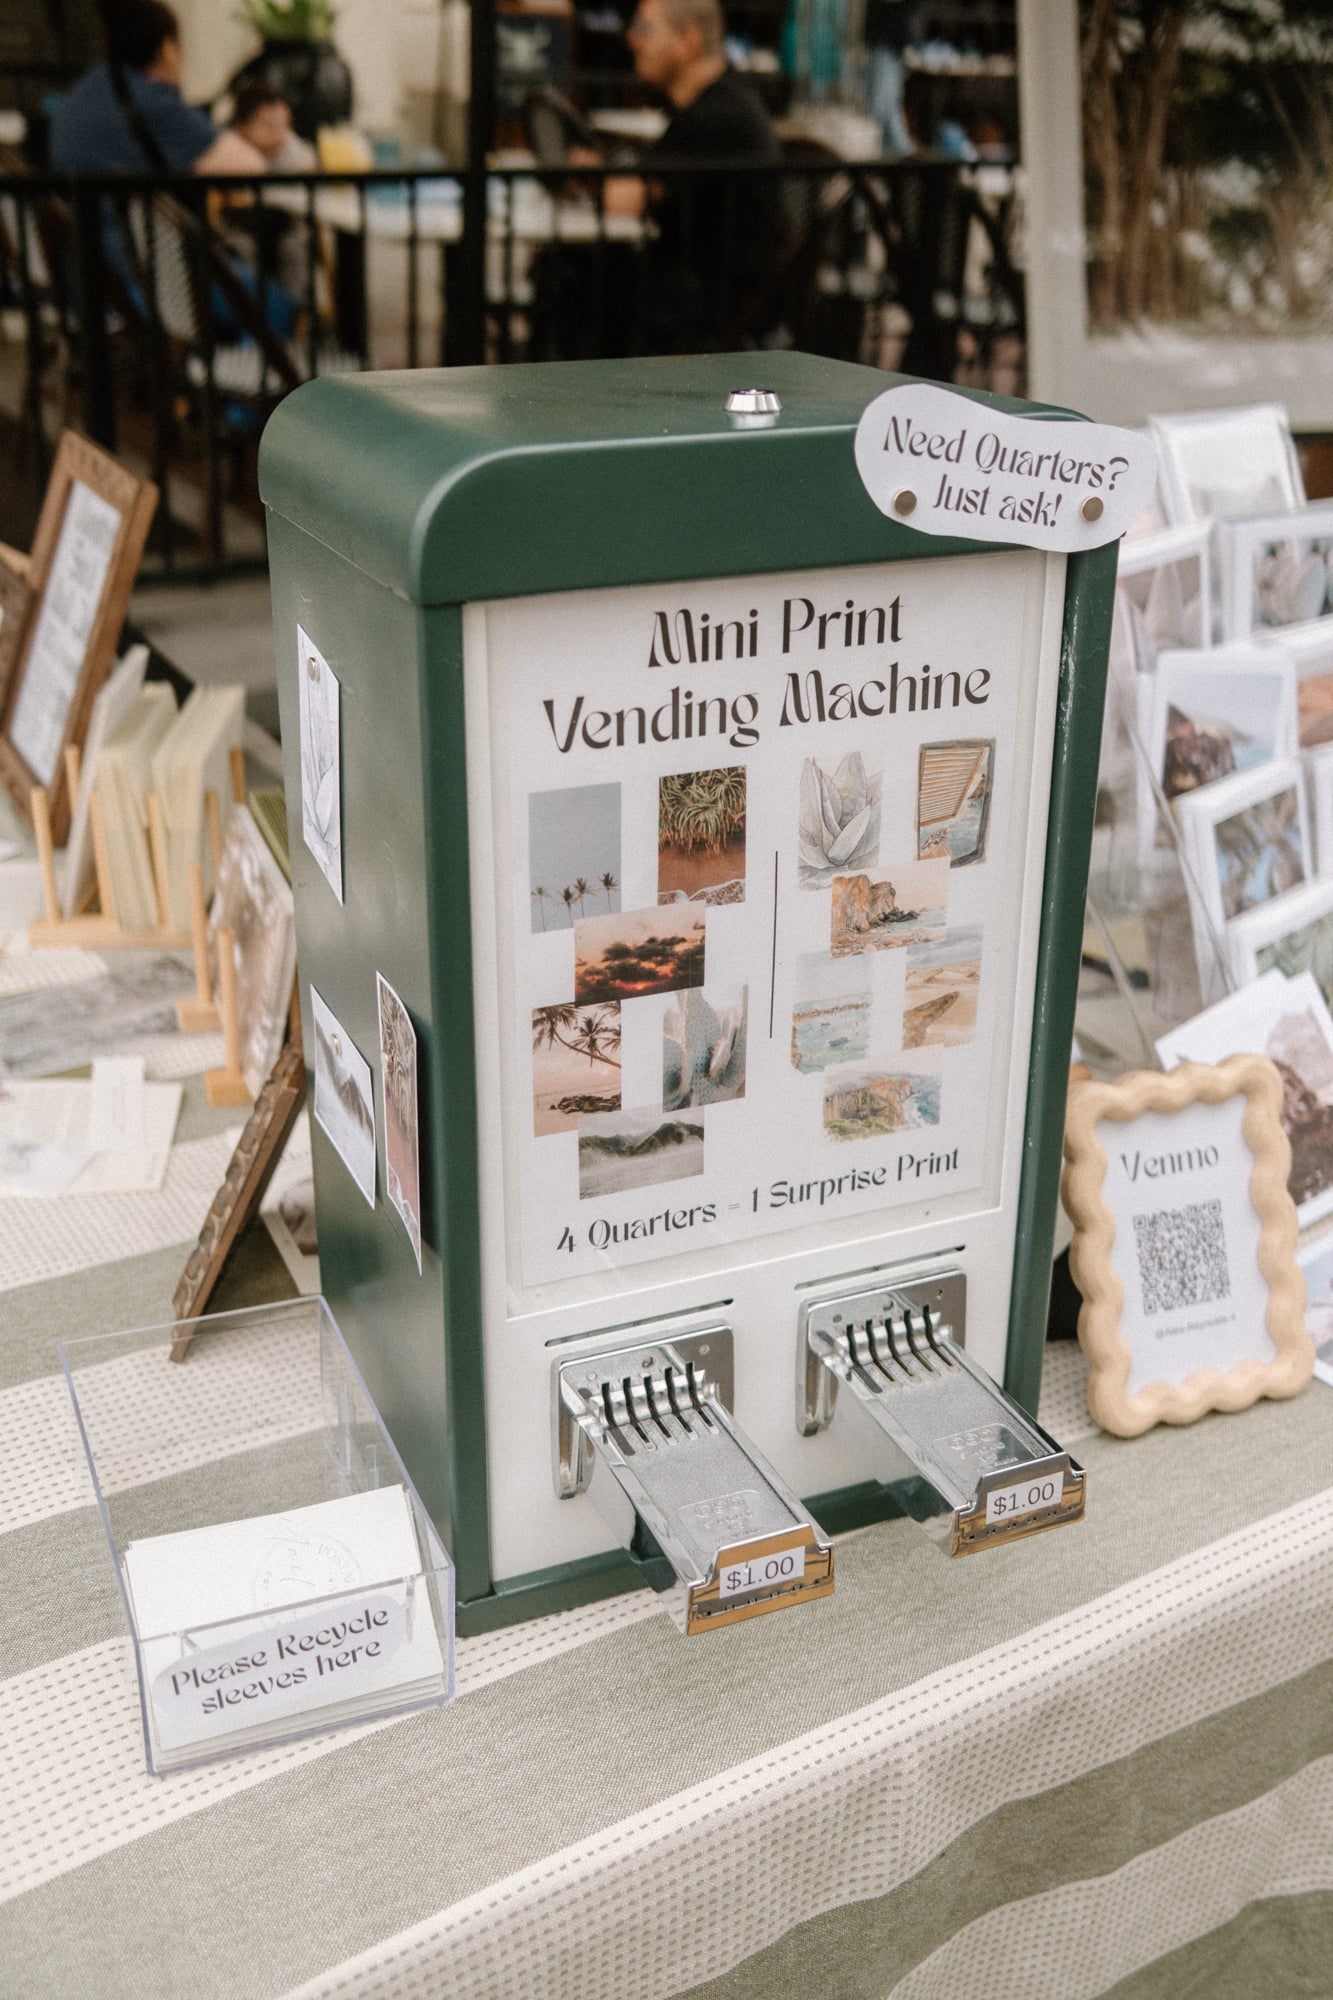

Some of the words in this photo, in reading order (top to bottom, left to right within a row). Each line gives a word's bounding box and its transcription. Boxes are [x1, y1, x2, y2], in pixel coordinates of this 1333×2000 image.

[884, 415, 967, 464] Need
[974, 432, 1130, 491] Quarters?
[932, 473, 991, 516] Just
[998, 491, 1063, 528] ask!
[648, 608, 759, 668] Mini
[782, 594, 904, 654] Print
[543, 685, 760, 754] Vending
[779, 661, 991, 727] Machine
[556, 1226, 578, 1253] 4
[588, 1203, 717, 1250] Quarters
[751, 1186, 760, 1213] 1
[769, 1166, 888, 1208] Surprise
[897, 1147, 960, 1182] Print
[1120, 1145, 1220, 1183] Venmo
[992, 1481, 1056, 1516] $1.00
[726, 1555, 795, 1592] $1.00
[171, 1650, 269, 1696] Please
[277, 1608, 390, 1661] Recycle
[201, 1666, 308, 1715] sleeves
[316, 1640, 382, 1676] here
